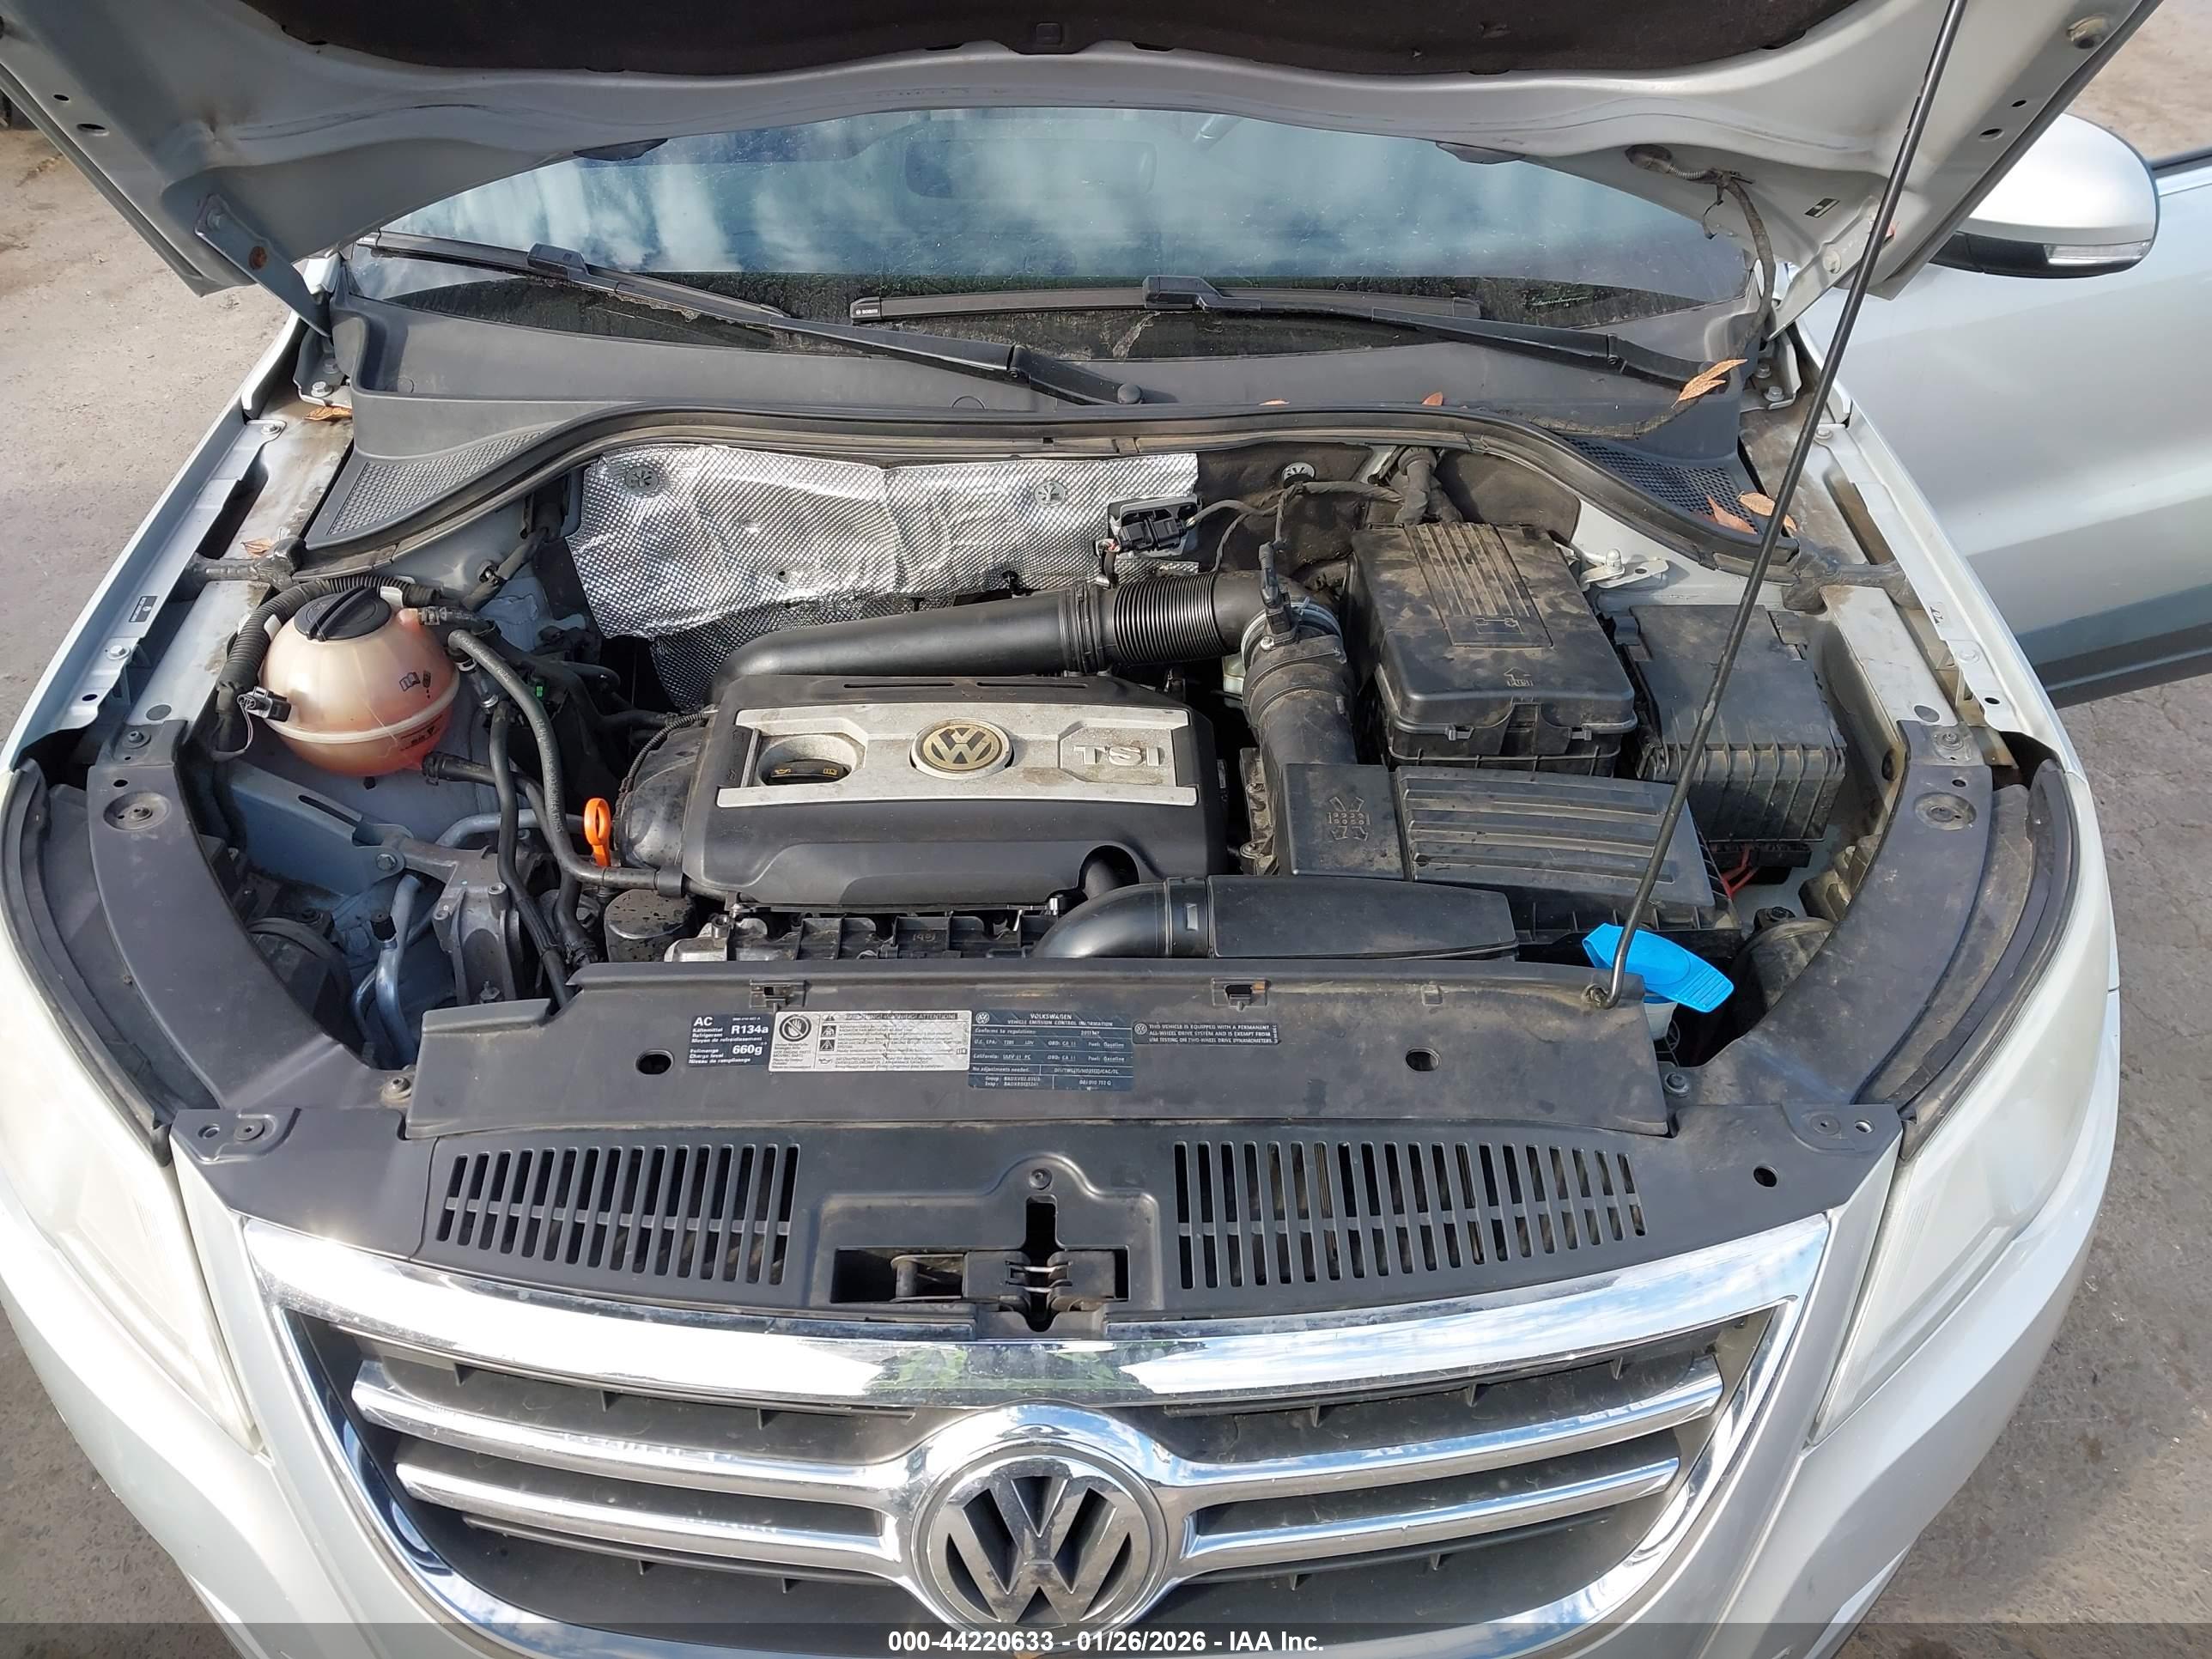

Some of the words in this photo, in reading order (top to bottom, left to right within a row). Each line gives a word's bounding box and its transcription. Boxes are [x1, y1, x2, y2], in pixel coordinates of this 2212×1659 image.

[1073, 744, 1164, 767] TSI
[693, 1017, 714, 1027] AC
[731, 1025, 769, 1035] R134a
[732, 1045, 763, 1055] 660g
